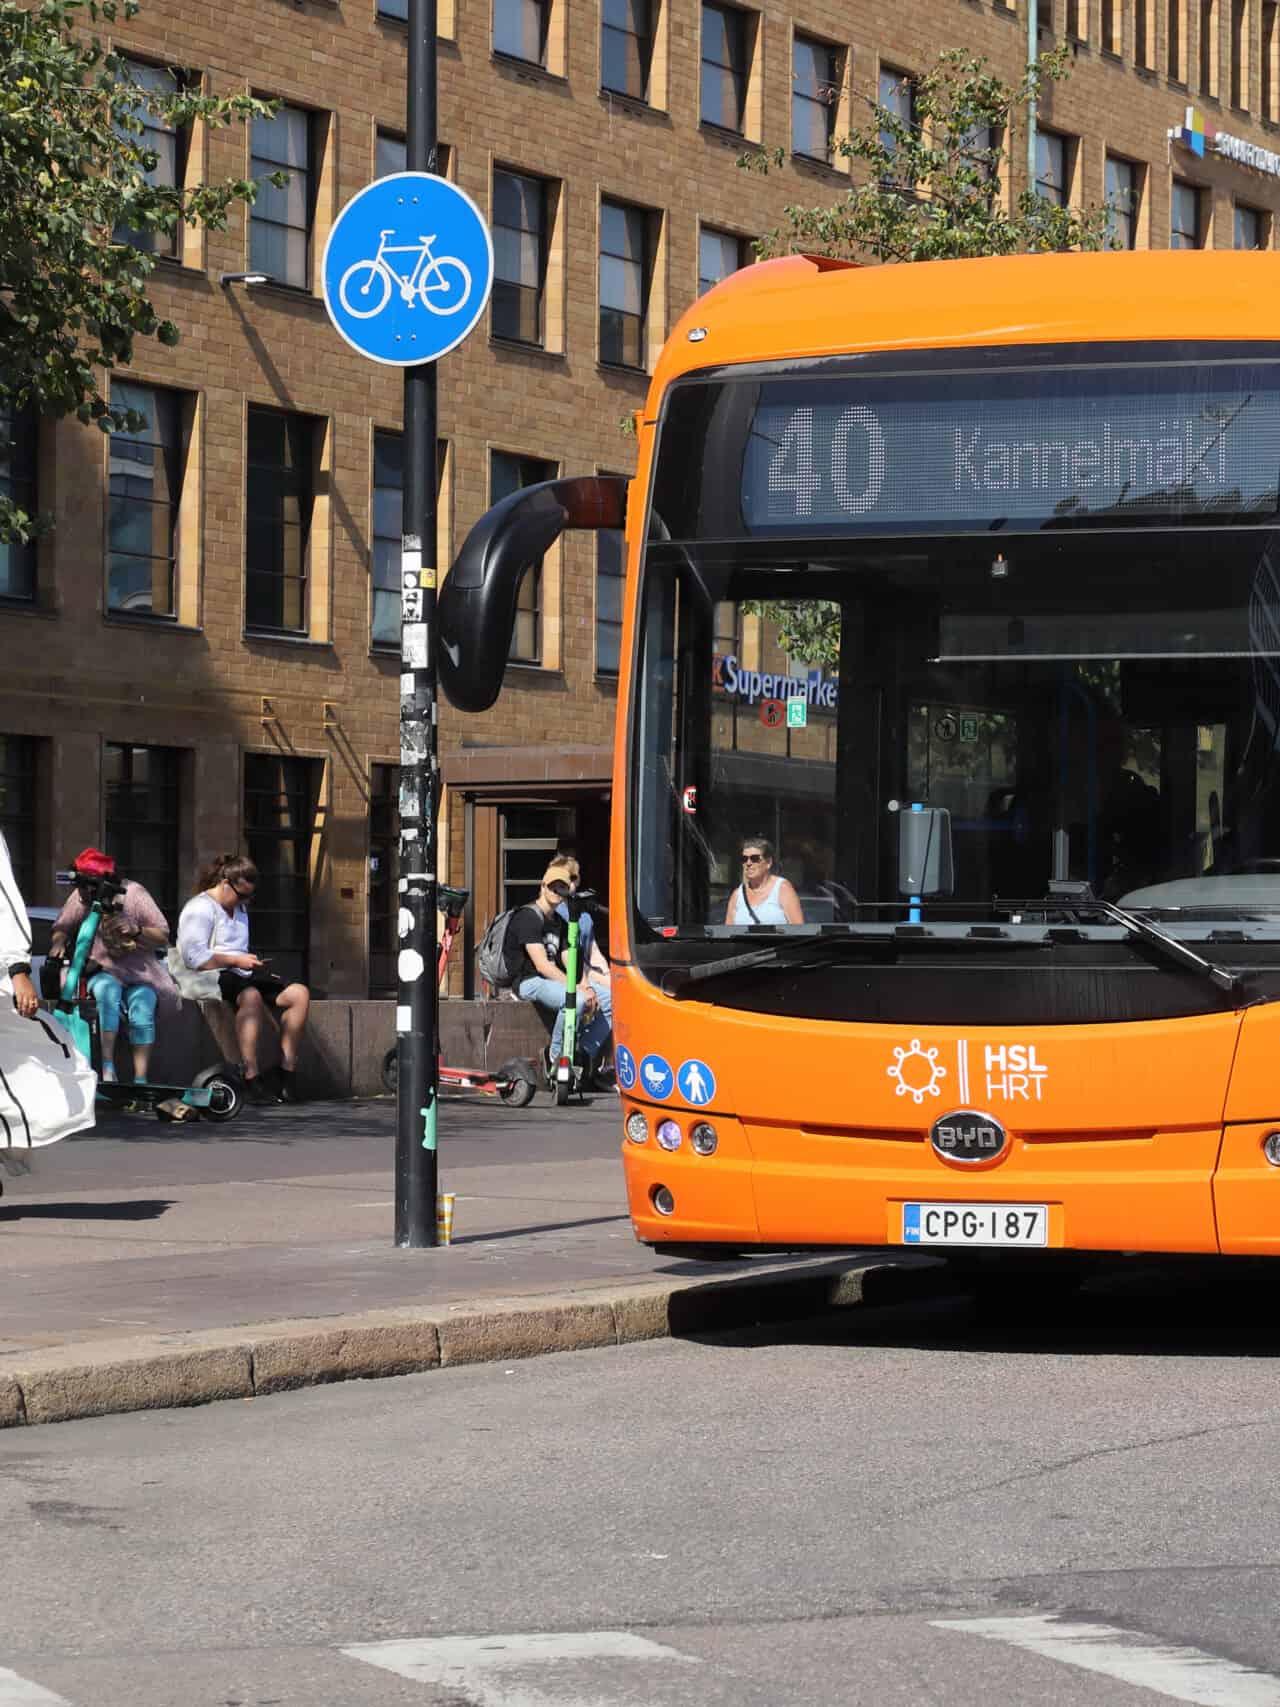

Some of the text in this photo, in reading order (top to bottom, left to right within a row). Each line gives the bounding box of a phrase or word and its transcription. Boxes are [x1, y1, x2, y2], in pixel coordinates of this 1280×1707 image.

[768, 405, 1227, 516] 40 Kannelmäki
[984, 1044, 1049, 1072] HSL
[985, 1073, 1049, 1101] HRT
[936, 1125, 997, 1148] BYD
[925, 1209, 1039, 1240] CPG-187
